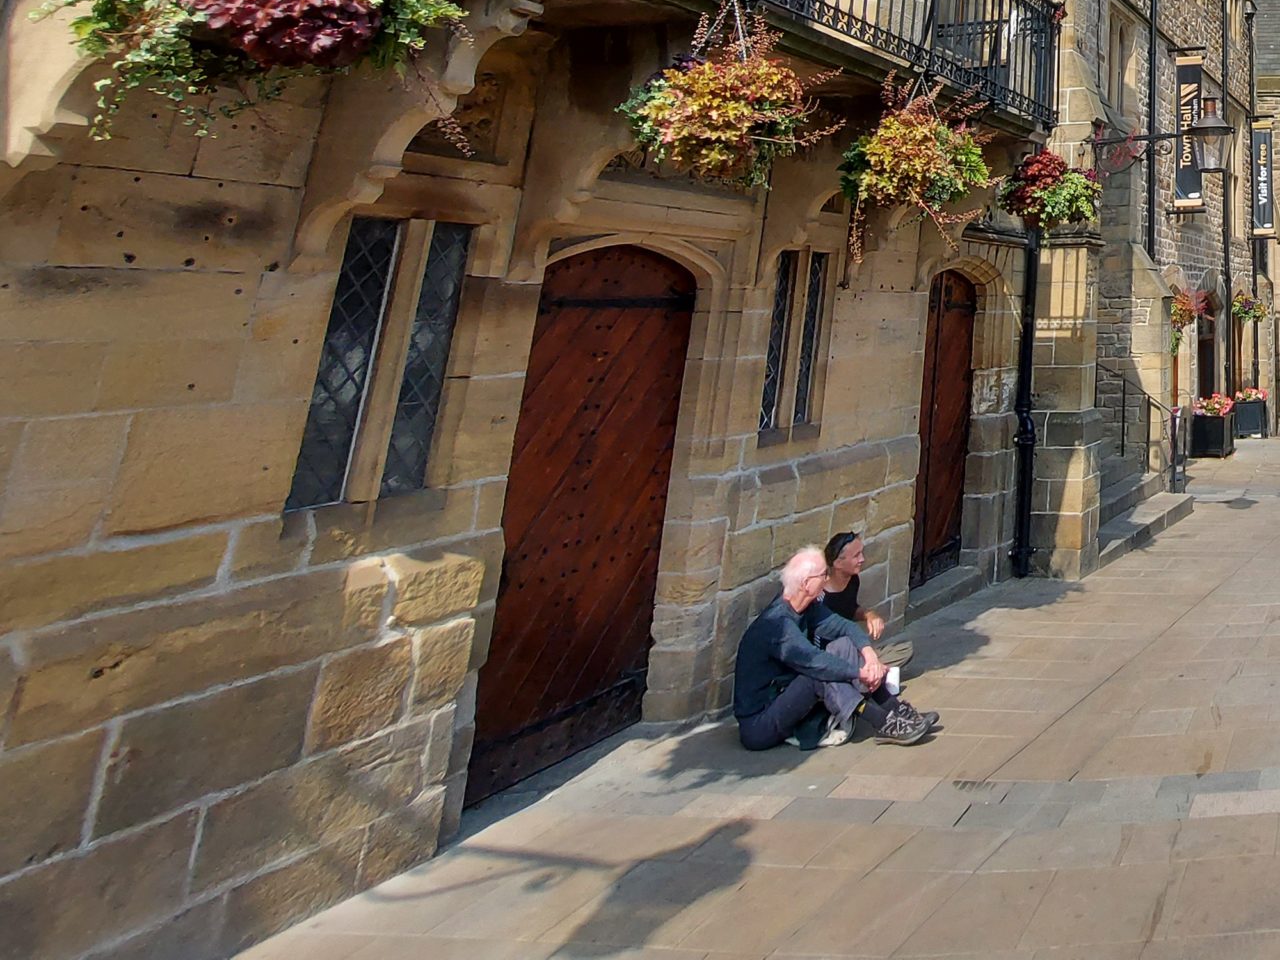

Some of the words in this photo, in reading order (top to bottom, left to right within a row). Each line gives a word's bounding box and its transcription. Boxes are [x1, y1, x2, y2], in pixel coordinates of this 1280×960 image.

[1180, 105, 1192, 131] Hall
[1191, 98, 1200, 127] Durham
[1180, 135, 1192, 169] Town
[1257, 143, 1268, 165] free
[1257, 165, 1268, 182] for
[1258, 182, 1268, 205] Visit
